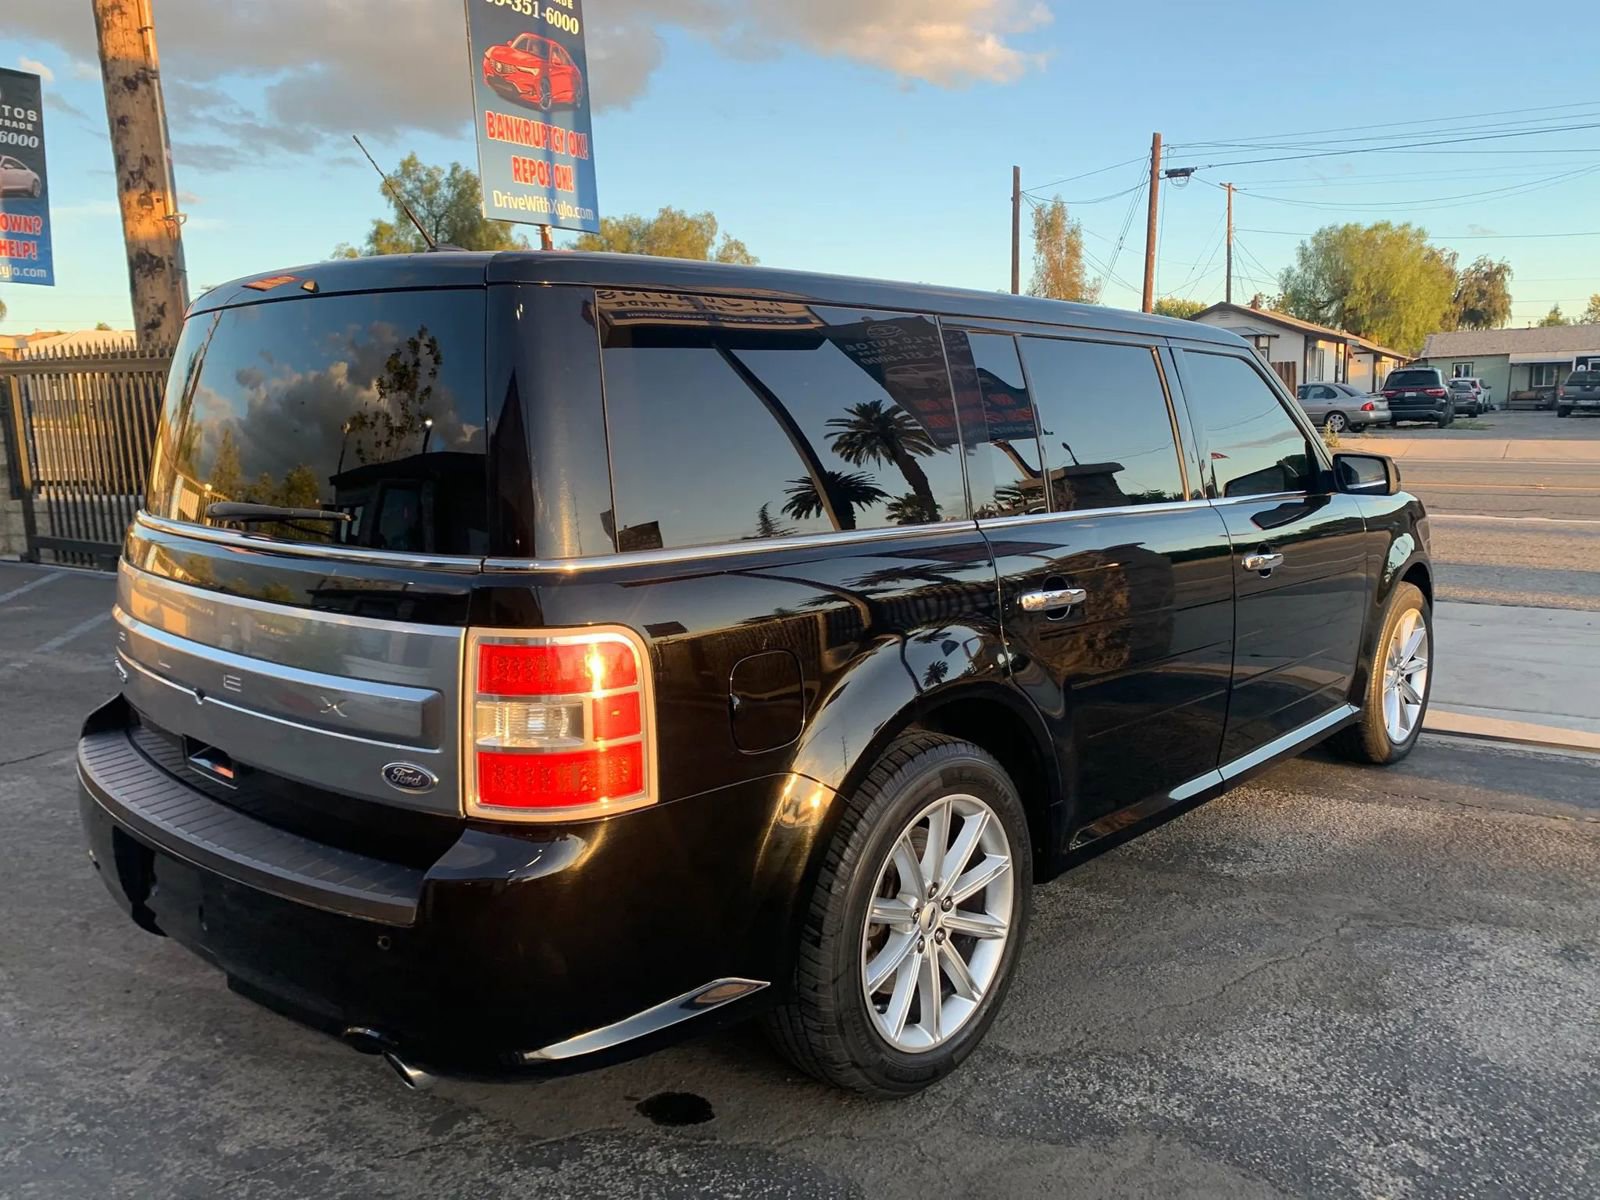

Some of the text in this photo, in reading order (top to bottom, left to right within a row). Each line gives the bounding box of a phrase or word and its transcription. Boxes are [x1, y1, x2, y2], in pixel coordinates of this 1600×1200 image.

[485, 0, 580, 35] -351-6000
[0, 131, 39, 148] 6000
[485, 110, 589, 160] BANKRUPTCY OK!
[511, 155, 575, 193] REPOS OK!
[492, 190, 594, 220] DriveWithXylo.com
[390, 767, 423, 786] Ford
